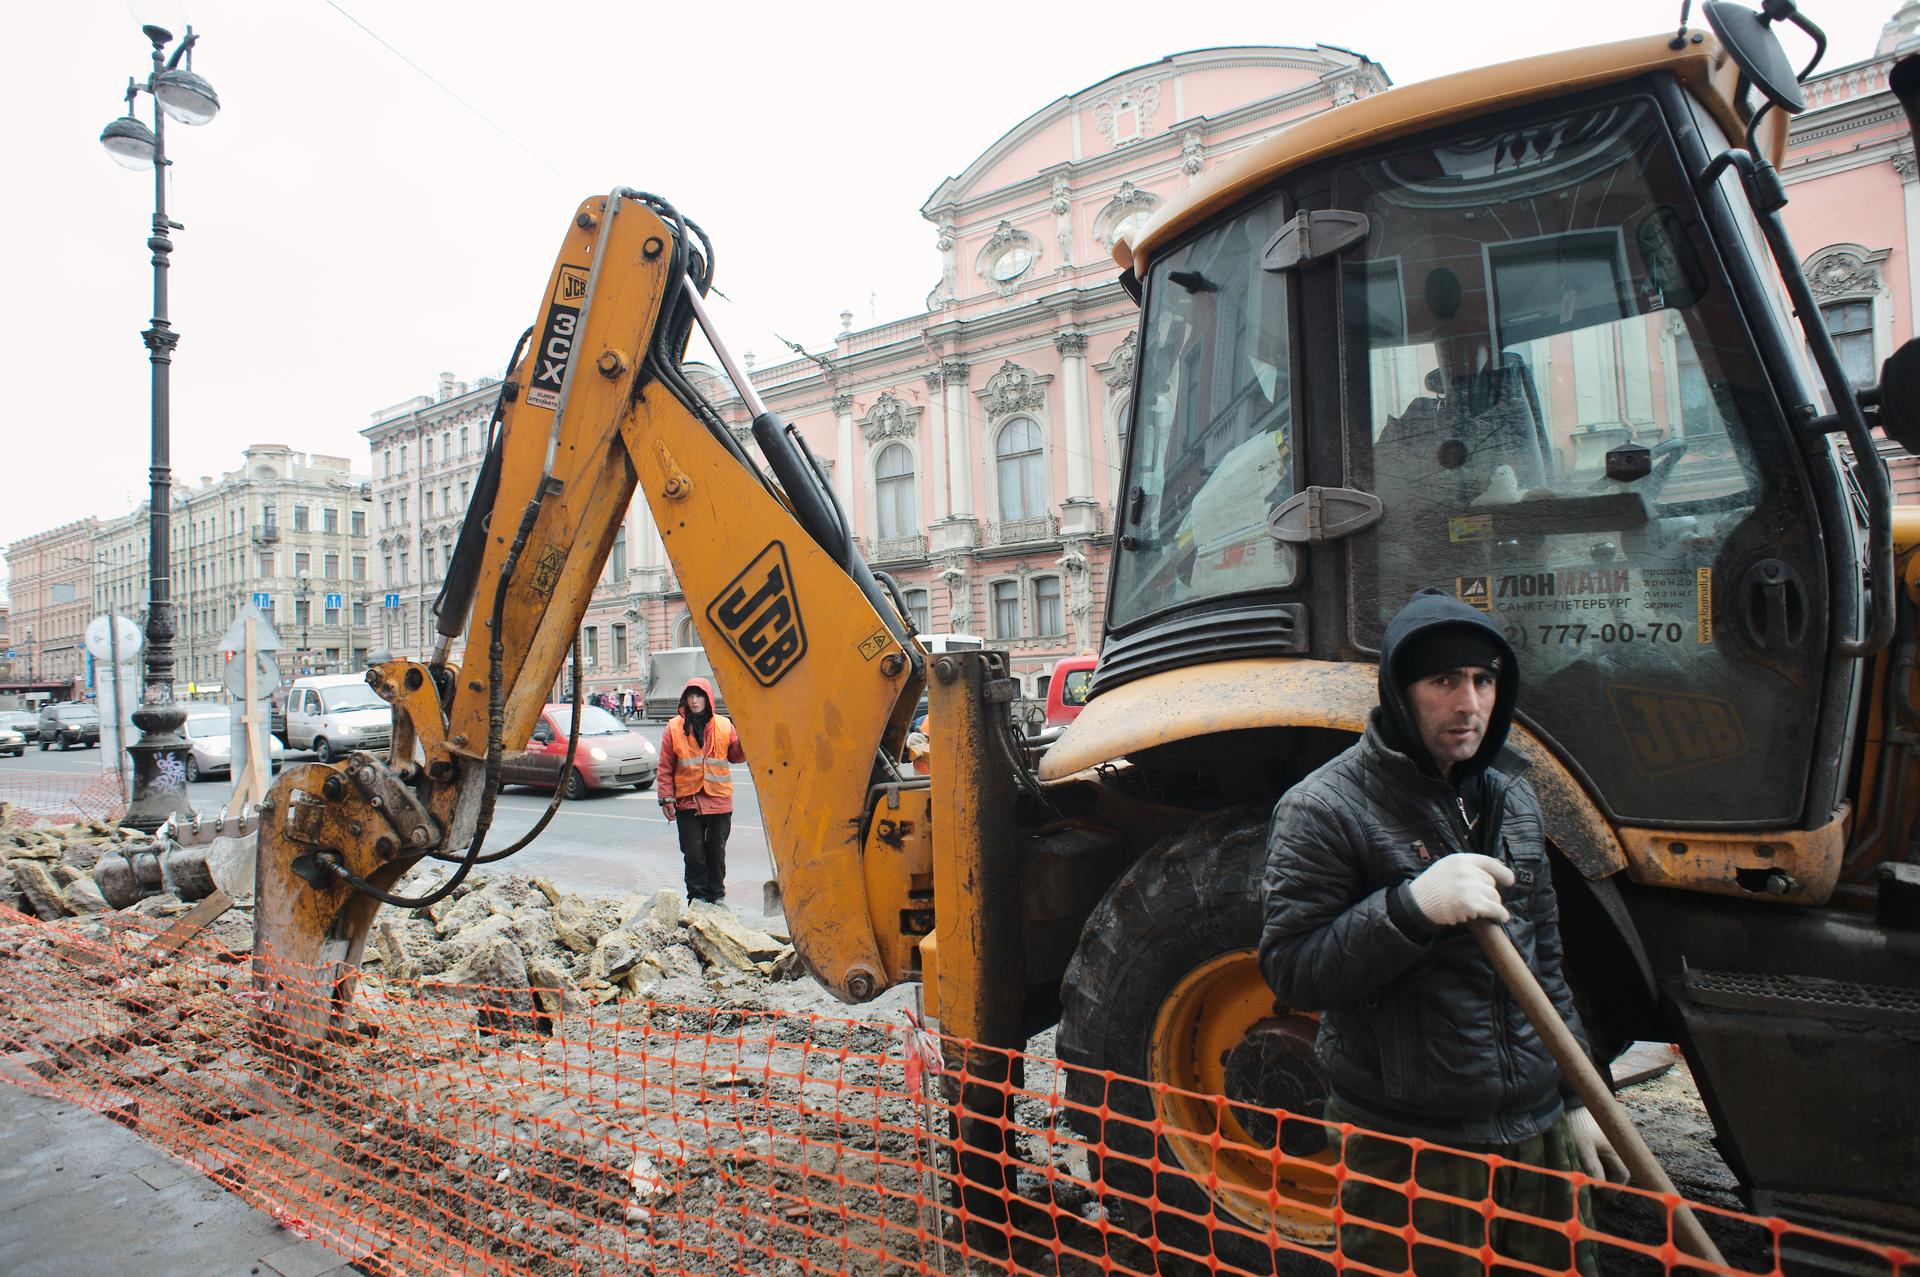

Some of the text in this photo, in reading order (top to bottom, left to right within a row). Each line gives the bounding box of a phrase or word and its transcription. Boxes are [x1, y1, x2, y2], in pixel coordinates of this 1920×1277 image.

[565, 276, 586, 298] JCB
[538, 313, 577, 385] 3CX
[1496, 568, 1631, 598] ЛОНМАДИ
[1642, 579, 1693, 588] аренда
[1643, 590, 1694, 598] лизинг
[1643, 601, 1684, 610] сервис
[718, 564, 799, 677] JCB
[1538, 622, 1682, 645] 777-00-70
[1631, 695, 1738, 763] JCB
